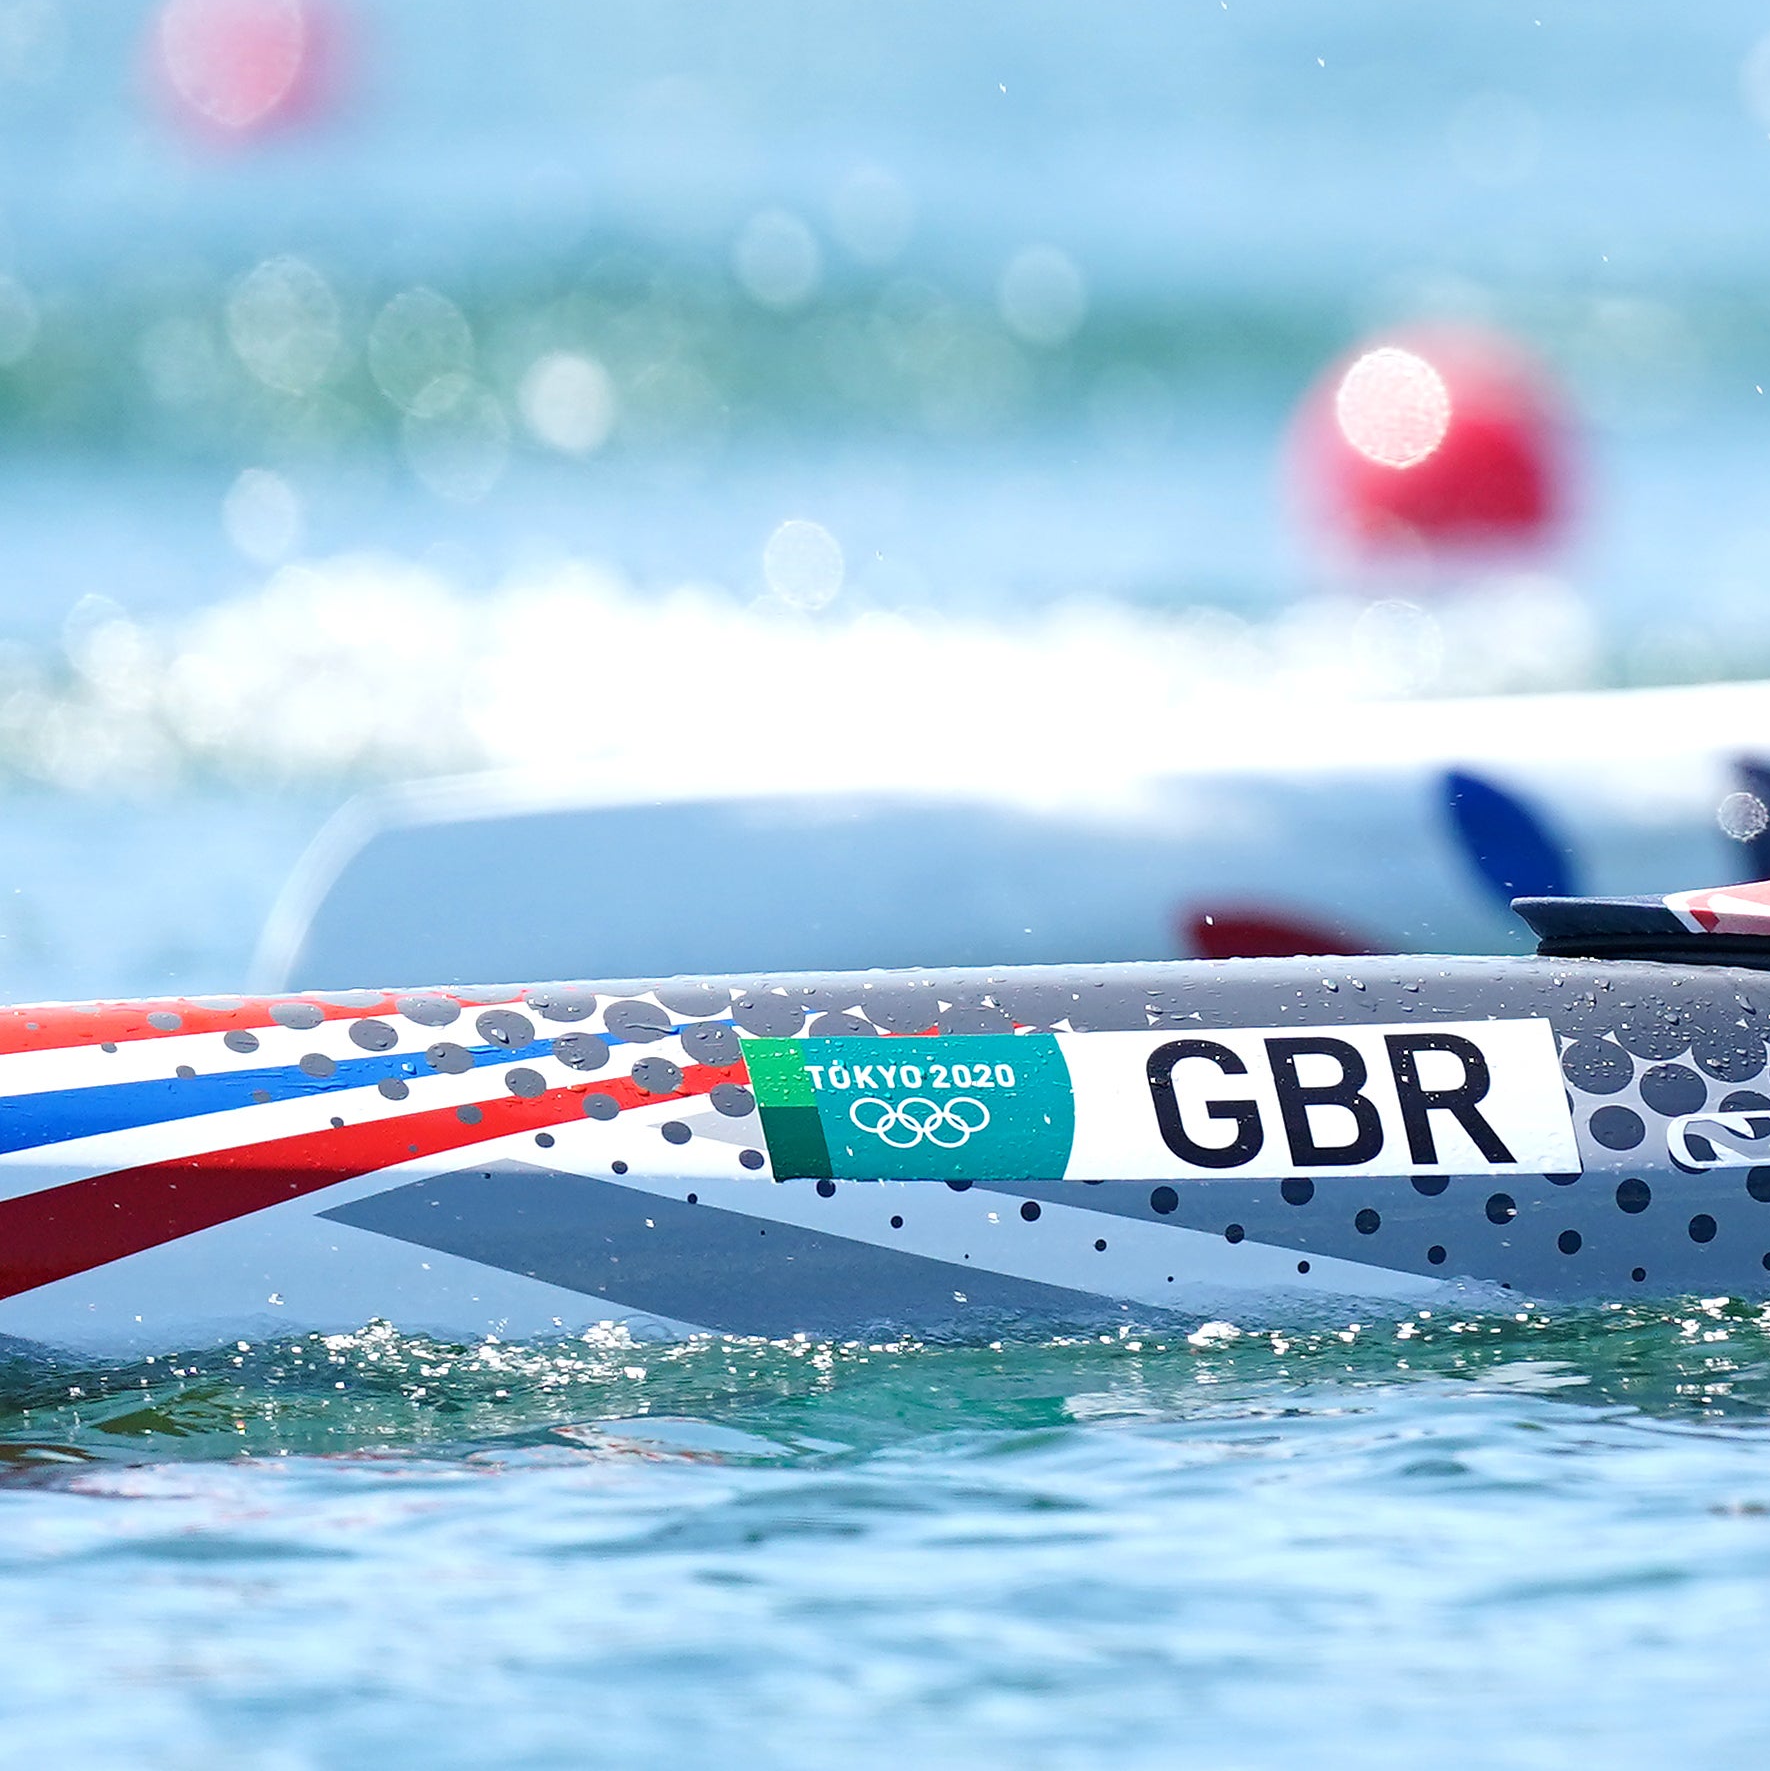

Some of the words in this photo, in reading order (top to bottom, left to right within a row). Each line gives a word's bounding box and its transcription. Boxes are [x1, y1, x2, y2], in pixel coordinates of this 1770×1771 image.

[803, 1064, 923, 1091] TOKYO
[929, 1063, 1016, 1089] 2020
[1144, 1031, 1519, 1169] GBR
